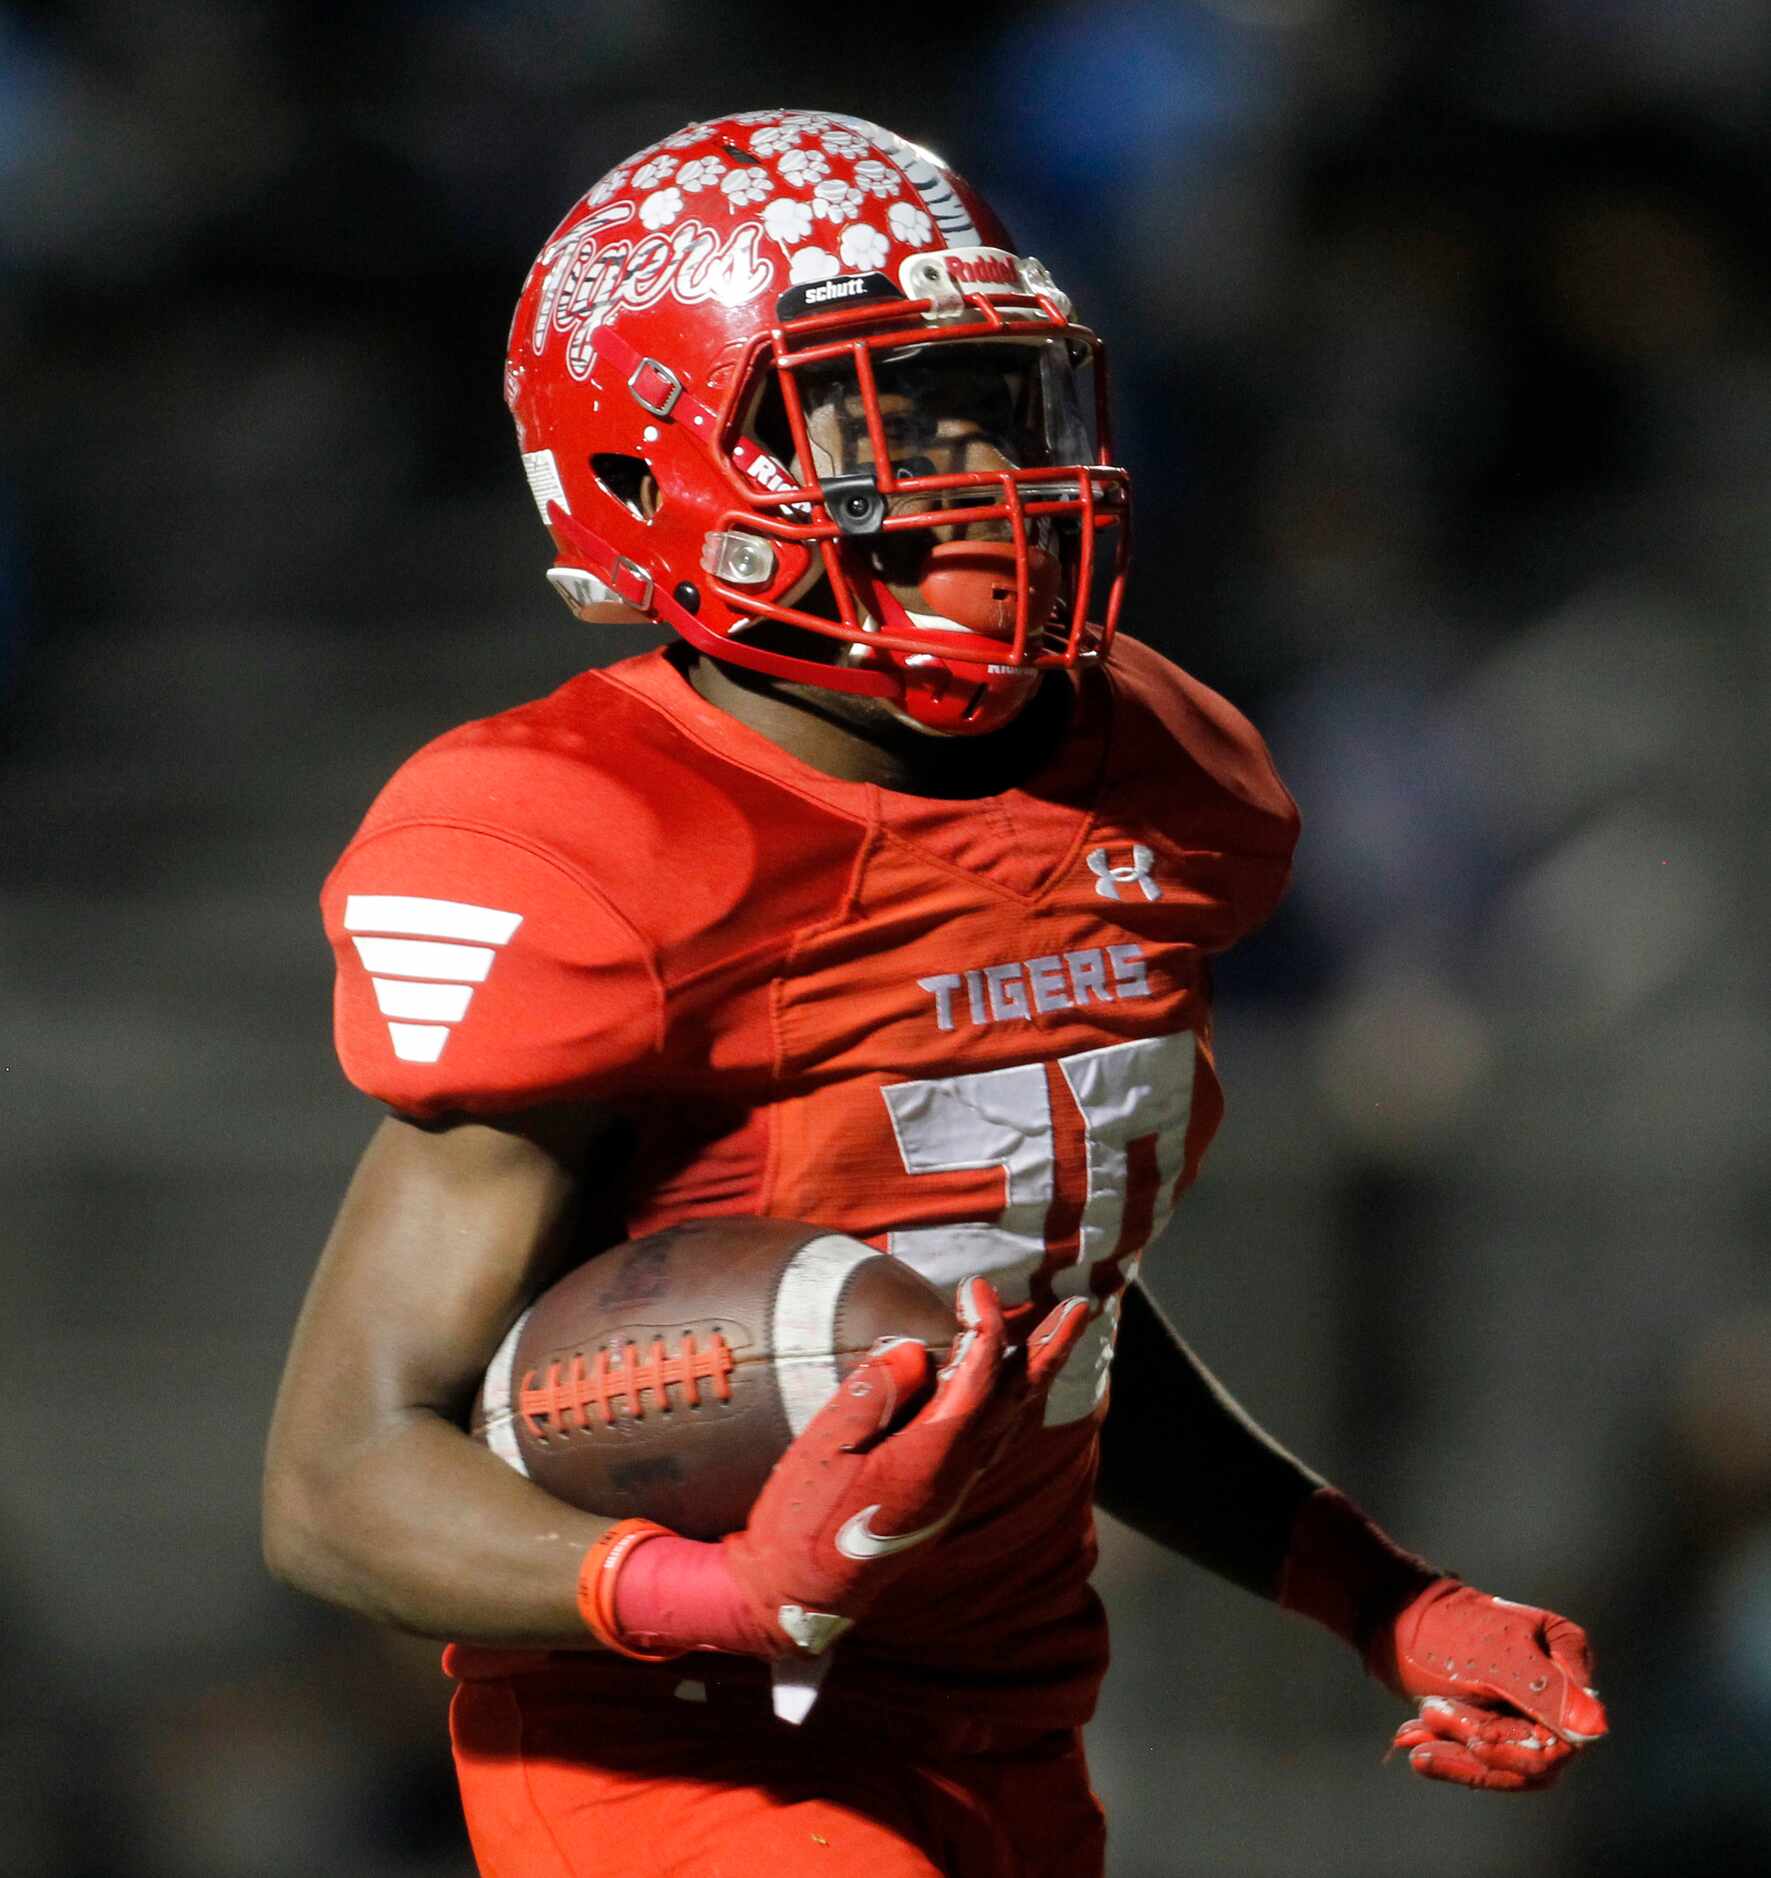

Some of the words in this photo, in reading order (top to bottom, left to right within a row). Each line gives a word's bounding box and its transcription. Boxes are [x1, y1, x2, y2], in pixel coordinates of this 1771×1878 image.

[532, 200, 774, 382] Tigers
[804, 277, 866, 304] schutt
[916, 943, 1153, 1032] TIGERS
